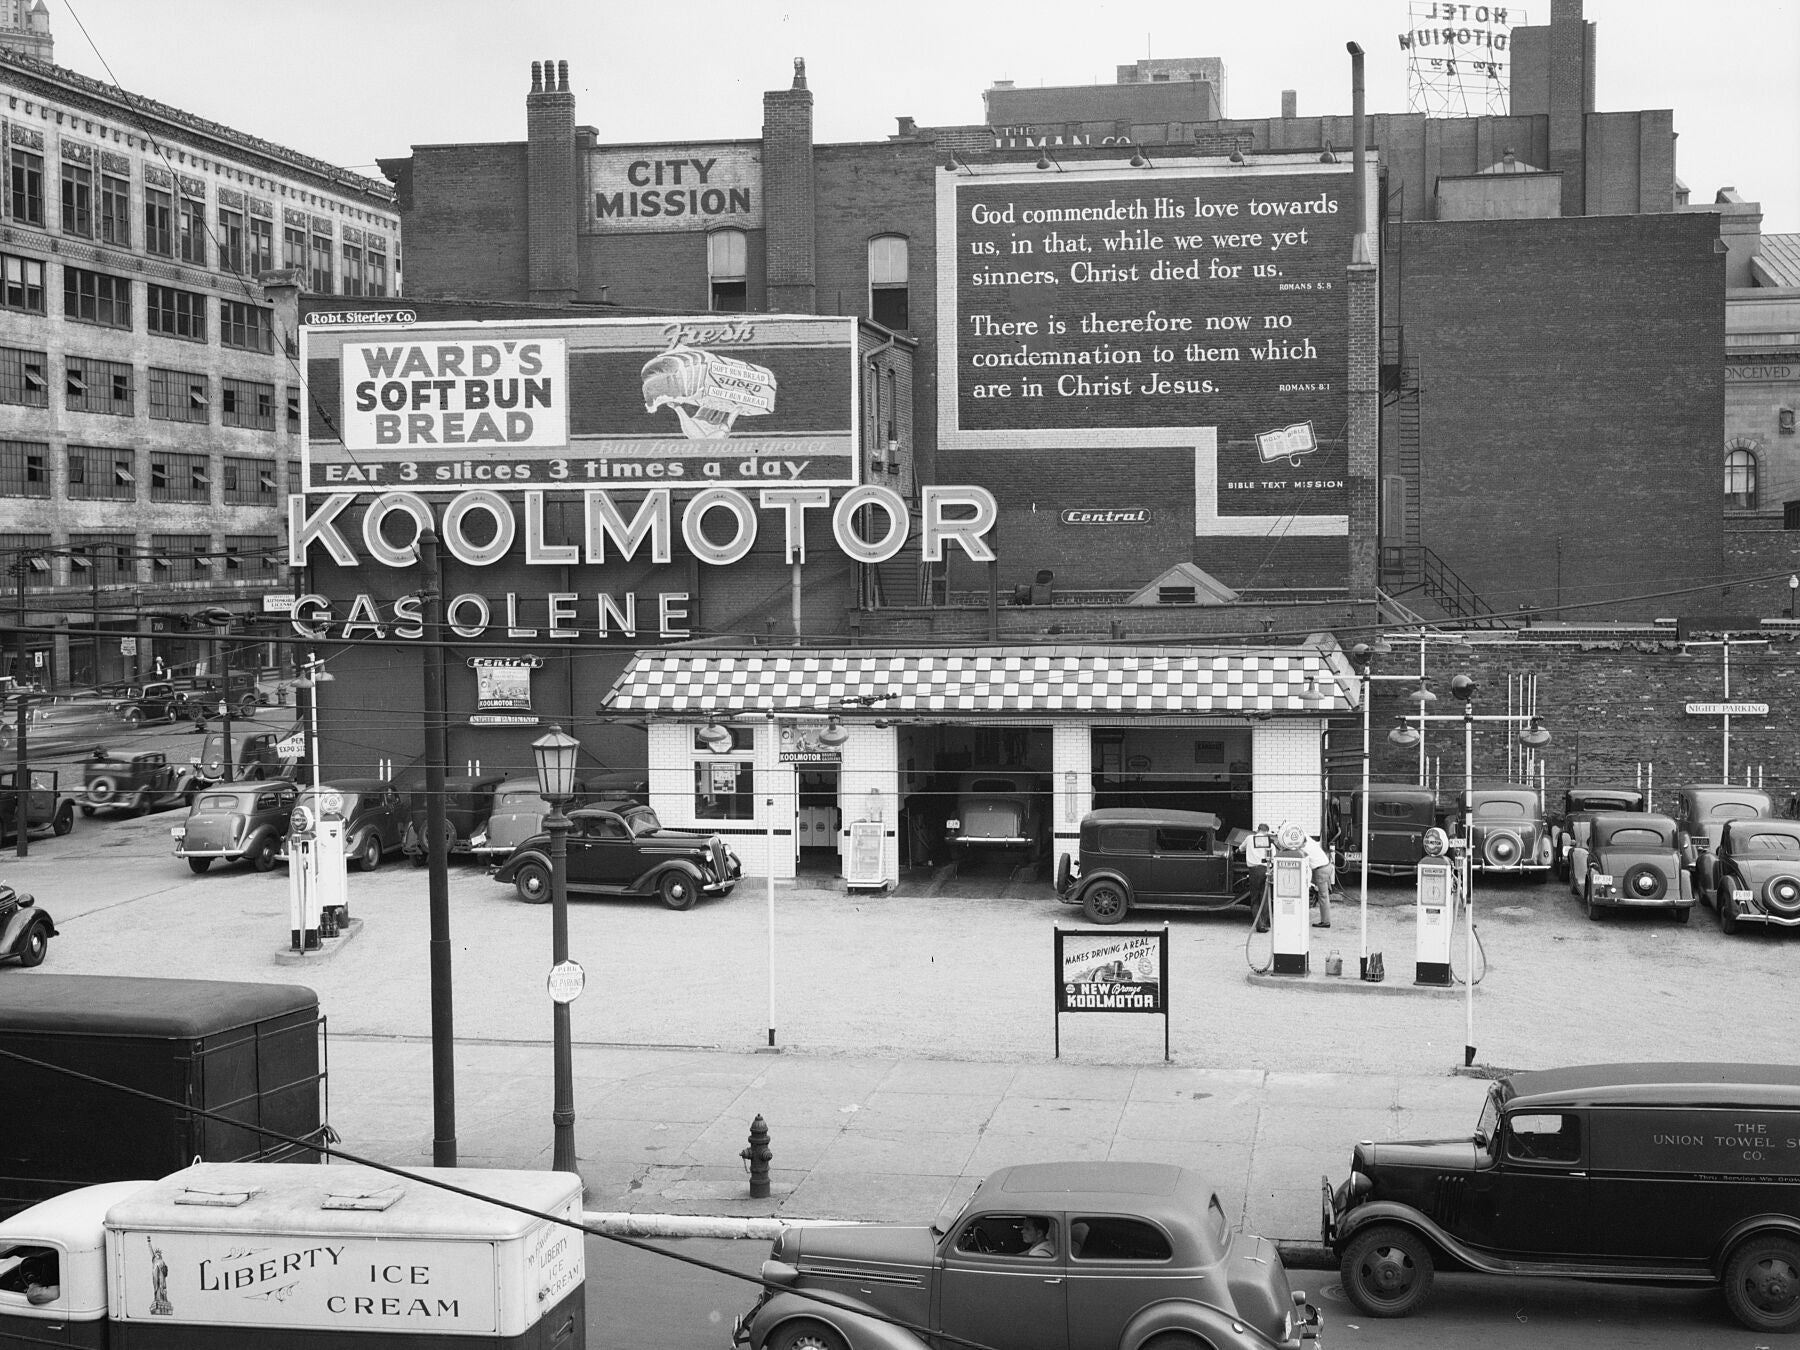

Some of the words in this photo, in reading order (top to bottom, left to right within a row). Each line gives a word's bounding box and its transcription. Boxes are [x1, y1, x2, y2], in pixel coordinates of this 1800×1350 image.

[1003, 127, 1035, 137] THE
[627, 158, 717, 187] CITY
[595, 188, 750, 218] MISSION
[971, 203, 1016, 225] God
[1022, 199, 1148, 223] commendeth
[1154, 197, 1186, 219] His
[1194, 197, 1239, 218] love
[1248, 193, 1338, 217] towards
[971, 241, 1000, 256] us,
[1010, 233, 1033, 254] in
[1042, 232, 1092, 253] that,
[1102, 229, 1164, 251] while
[1174, 235, 1203, 250] we
[1211, 233, 1262, 249] were
[1271, 228, 1308, 251] yet
[972, 265, 1059, 286] sinners,
[1070, 262, 1139, 284] Christ
[1150, 259, 1199, 280] died
[1208, 258, 1242, 279] for
[1252, 263, 1283, 278] us.
[1279, 283, 1312, 291] ROMANS
[311, 313, 345, 324] Robt.
[396, 311, 414, 322] Co.
[970, 315, 1039, 336] There
[1048, 315, 1067, 335] is
[1080, 310, 1193, 333] therefore
[1206, 316, 1252, 331] now
[1264, 314, 1292, 329] no
[661, 321, 755, 349] Fresh
[361, 342, 543, 379] WARD'S
[972, 344, 1142, 367] condemnation
[1153, 345, 1175, 363] to
[1184, 343, 1240, 362] them
[1249, 338, 1317, 361] which
[356, 379, 456, 412] SOFT
[465, 378, 551, 410] BUN
[718, 377, 762, 393] SLICED
[973, 383, 1012, 398] are
[1021, 376, 1043, 397] in
[1057, 374, 1132, 397] Christ
[1141, 373, 1220, 395] Jesus.
[1279, 383, 1316, 392] ROMANS
[375, 411, 533, 445] BREAD
[325, 464, 384, 481] EAT
[399, 462, 418, 481] 3
[435, 461, 531, 480] slices
[549, 459, 569, 479] 3
[584, 458, 685, 478] times
[702, 462, 721, 477] a
[738, 457, 811, 481] day
[1228, 481, 1255, 489] BIBLE
[1261, 481, 1287, 489] TEXT
[1294, 480, 1343, 489] MISSION
[289, 484, 998, 568] KOOLMOTOR
[1067, 510, 1145, 522] Central
[291, 593, 690, 639] GASOLENE
[781, 753, 821, 761] KOOLMOTOR
[1065, 952, 1090, 966] MAKES
[1091, 944, 1120, 959] DRIVING
[1123, 942, 1129, 951] A
[1130, 937, 1149, 949] REAL
[1124, 944, 1156, 962] SPORT!
[1067, 994, 1154, 1008] KOOLMOTOR
[1081, 983, 1111, 995] NEW
[1112, 983, 1142, 998] Bronze
[1734, 1123, 1767, 1134] THE
[1653, 1134, 1704, 1146] UNION
[1714, 1136, 1775, 1148] TOWEL
[1743, 1150, 1766, 1161] CO.
[540, 1237, 568, 1269] LIBERTY
[199, 1246, 346, 1291] LIBERTY
[371, 1264, 430, 1285] ICE
[549, 1259, 565, 1281] ICE
[327, 1295, 460, 1318] CREAM
